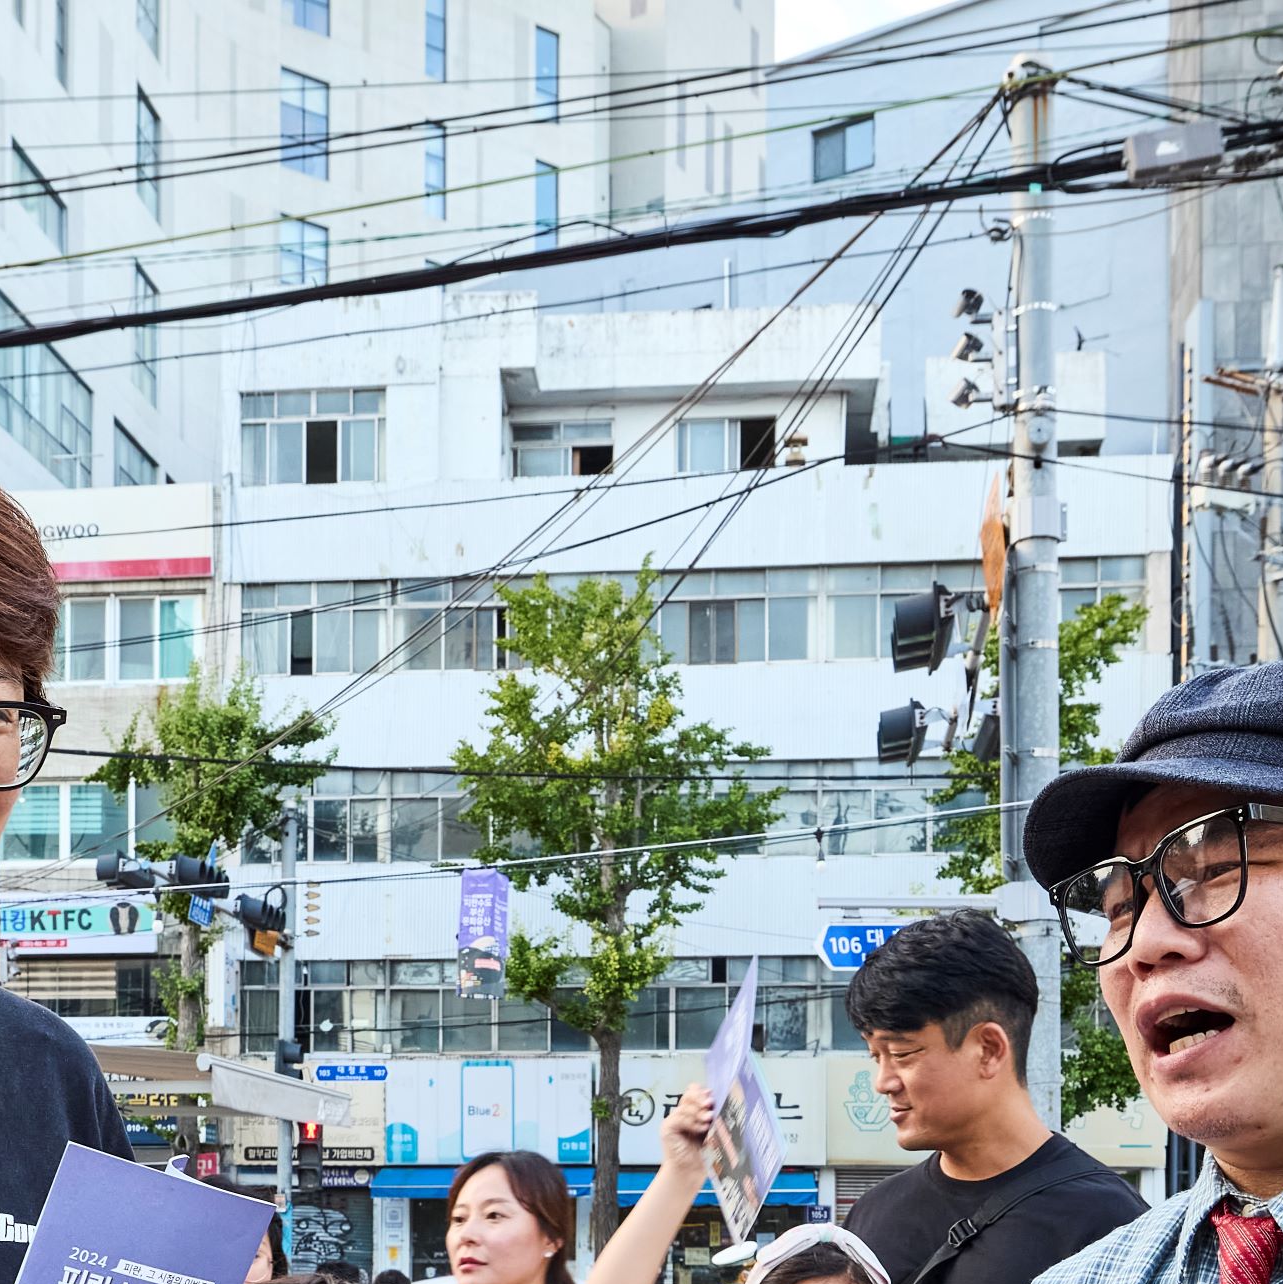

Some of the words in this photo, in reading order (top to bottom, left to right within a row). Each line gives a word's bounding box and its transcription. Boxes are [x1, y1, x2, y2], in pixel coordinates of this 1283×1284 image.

[30, 908, 93, 931] KTFC
[829, 936, 862, 954] 106
[866, 928, 900, 948] 대
[69, 1247, 108, 1268] 2024
